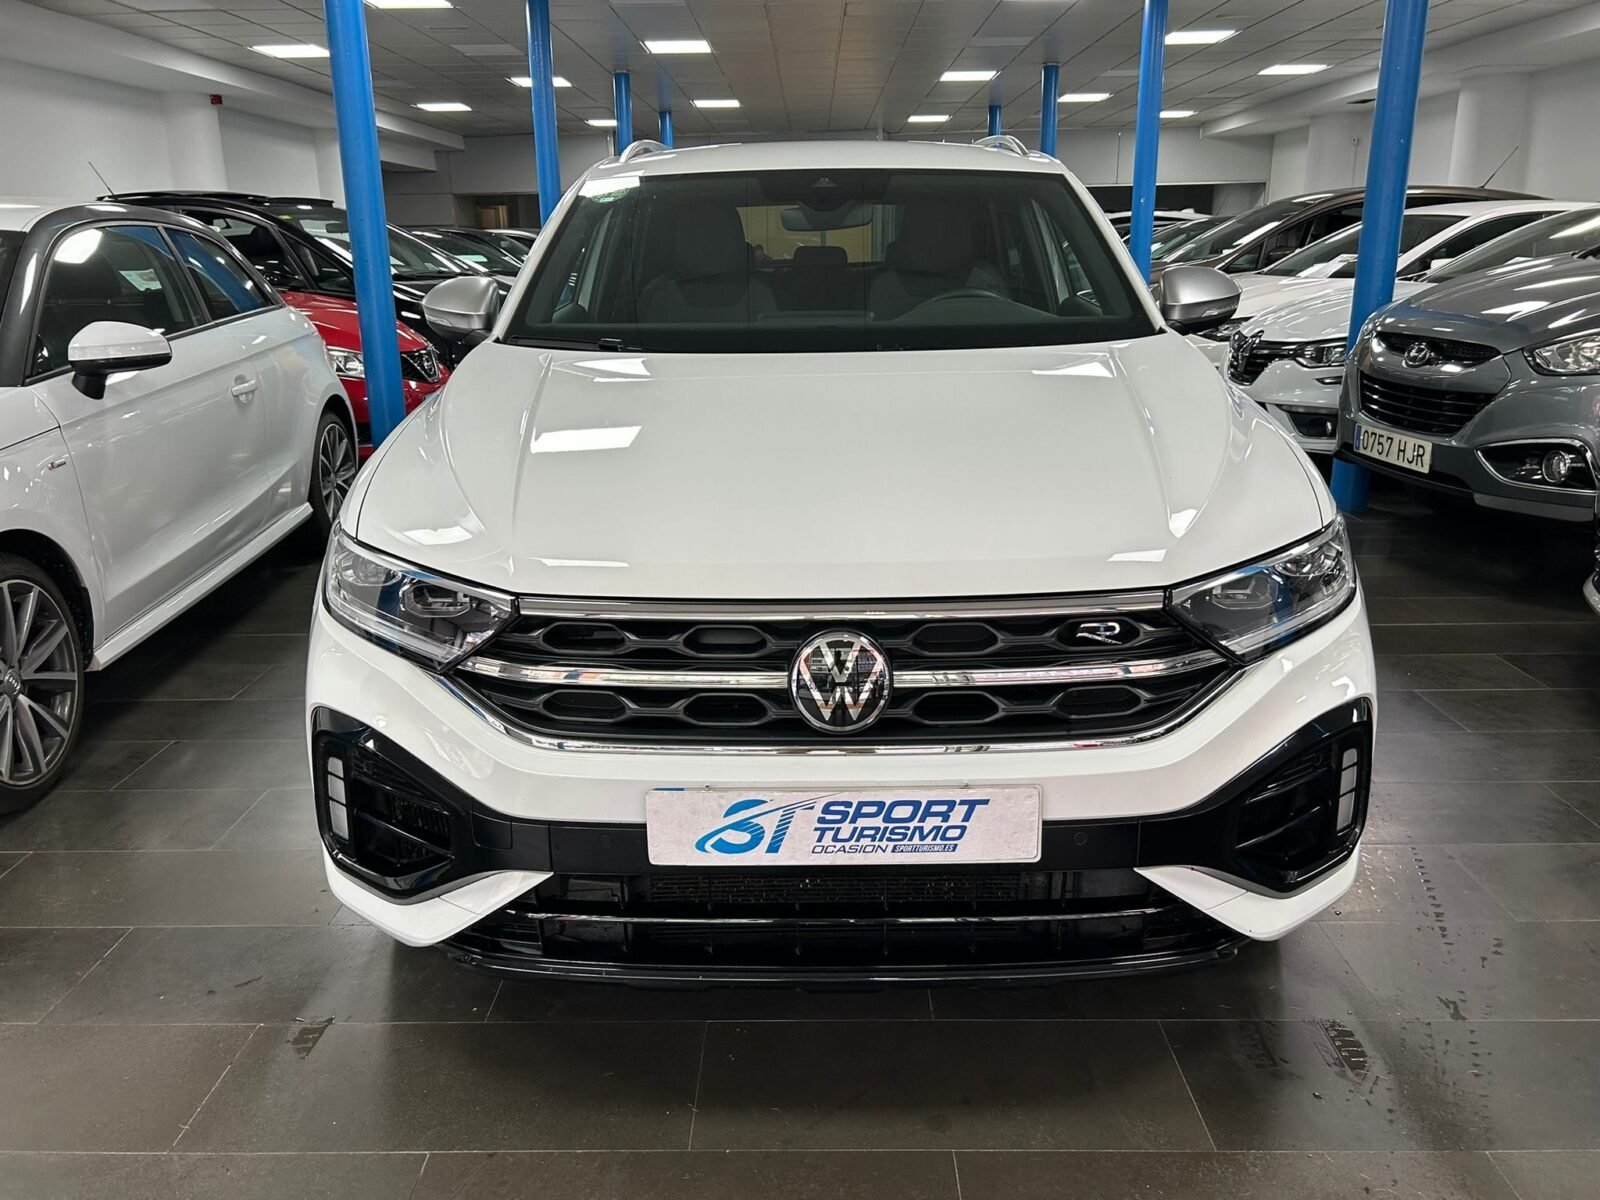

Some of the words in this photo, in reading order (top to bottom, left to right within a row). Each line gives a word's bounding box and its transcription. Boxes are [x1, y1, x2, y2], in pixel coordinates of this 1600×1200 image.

[1362, 430, 1393, 457] 0757
[1397, 440, 1426, 467] HJR
[817, 799, 990, 824] SPORT
[813, 825, 967, 843] TURISMO
[811, 844, 888, 854] OCASION
[894, 844, 954, 853] SPORTTURISMO.ES
